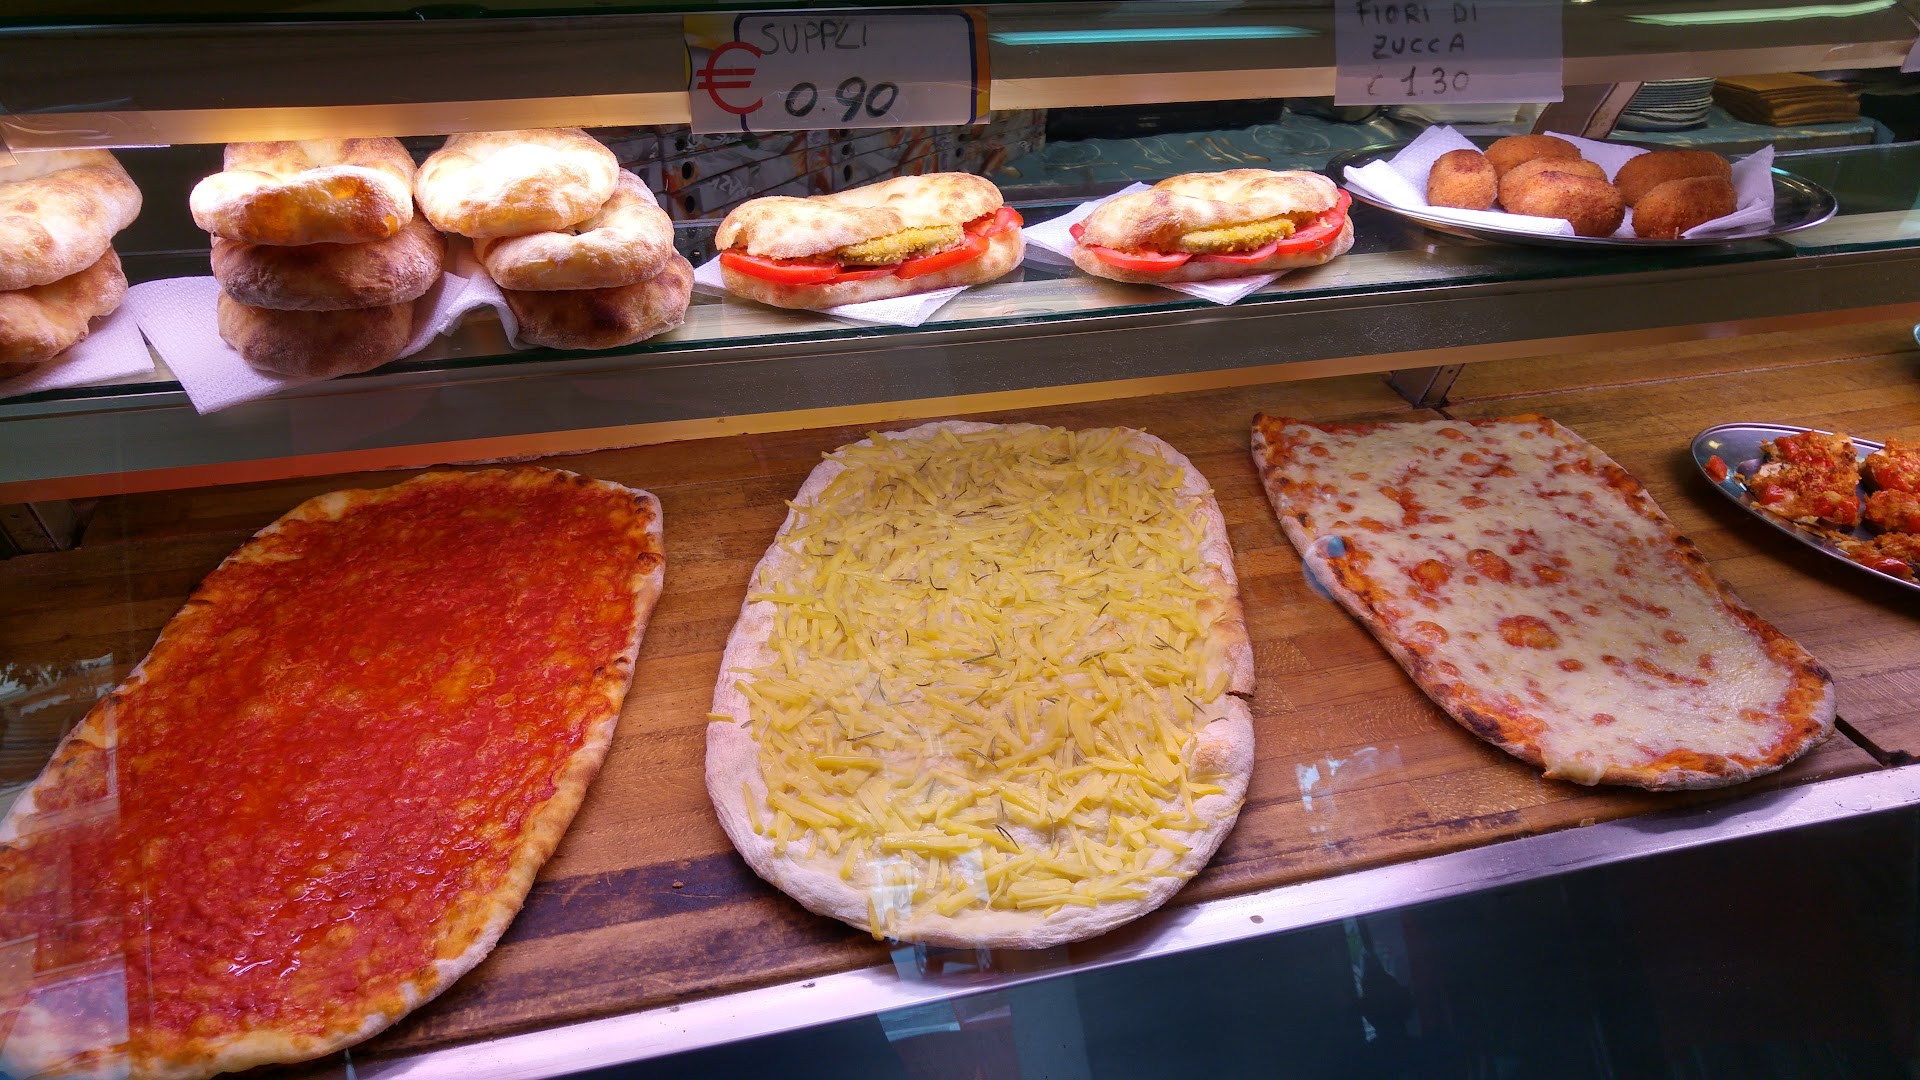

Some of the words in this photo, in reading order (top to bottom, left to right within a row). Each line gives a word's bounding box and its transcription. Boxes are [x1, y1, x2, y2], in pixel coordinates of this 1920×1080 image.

[1356, 0, 1430, 26] FIORI
[1453, 2, 1477, 24] DI
[760, 20, 867, 55] SUPPLI
[1372, 32, 1465, 59] ZUCCA
[696, 41, 763, 114] €
[785, 76, 899, 122] 0.90
[1400, 65, 1469, 96] 1.30
